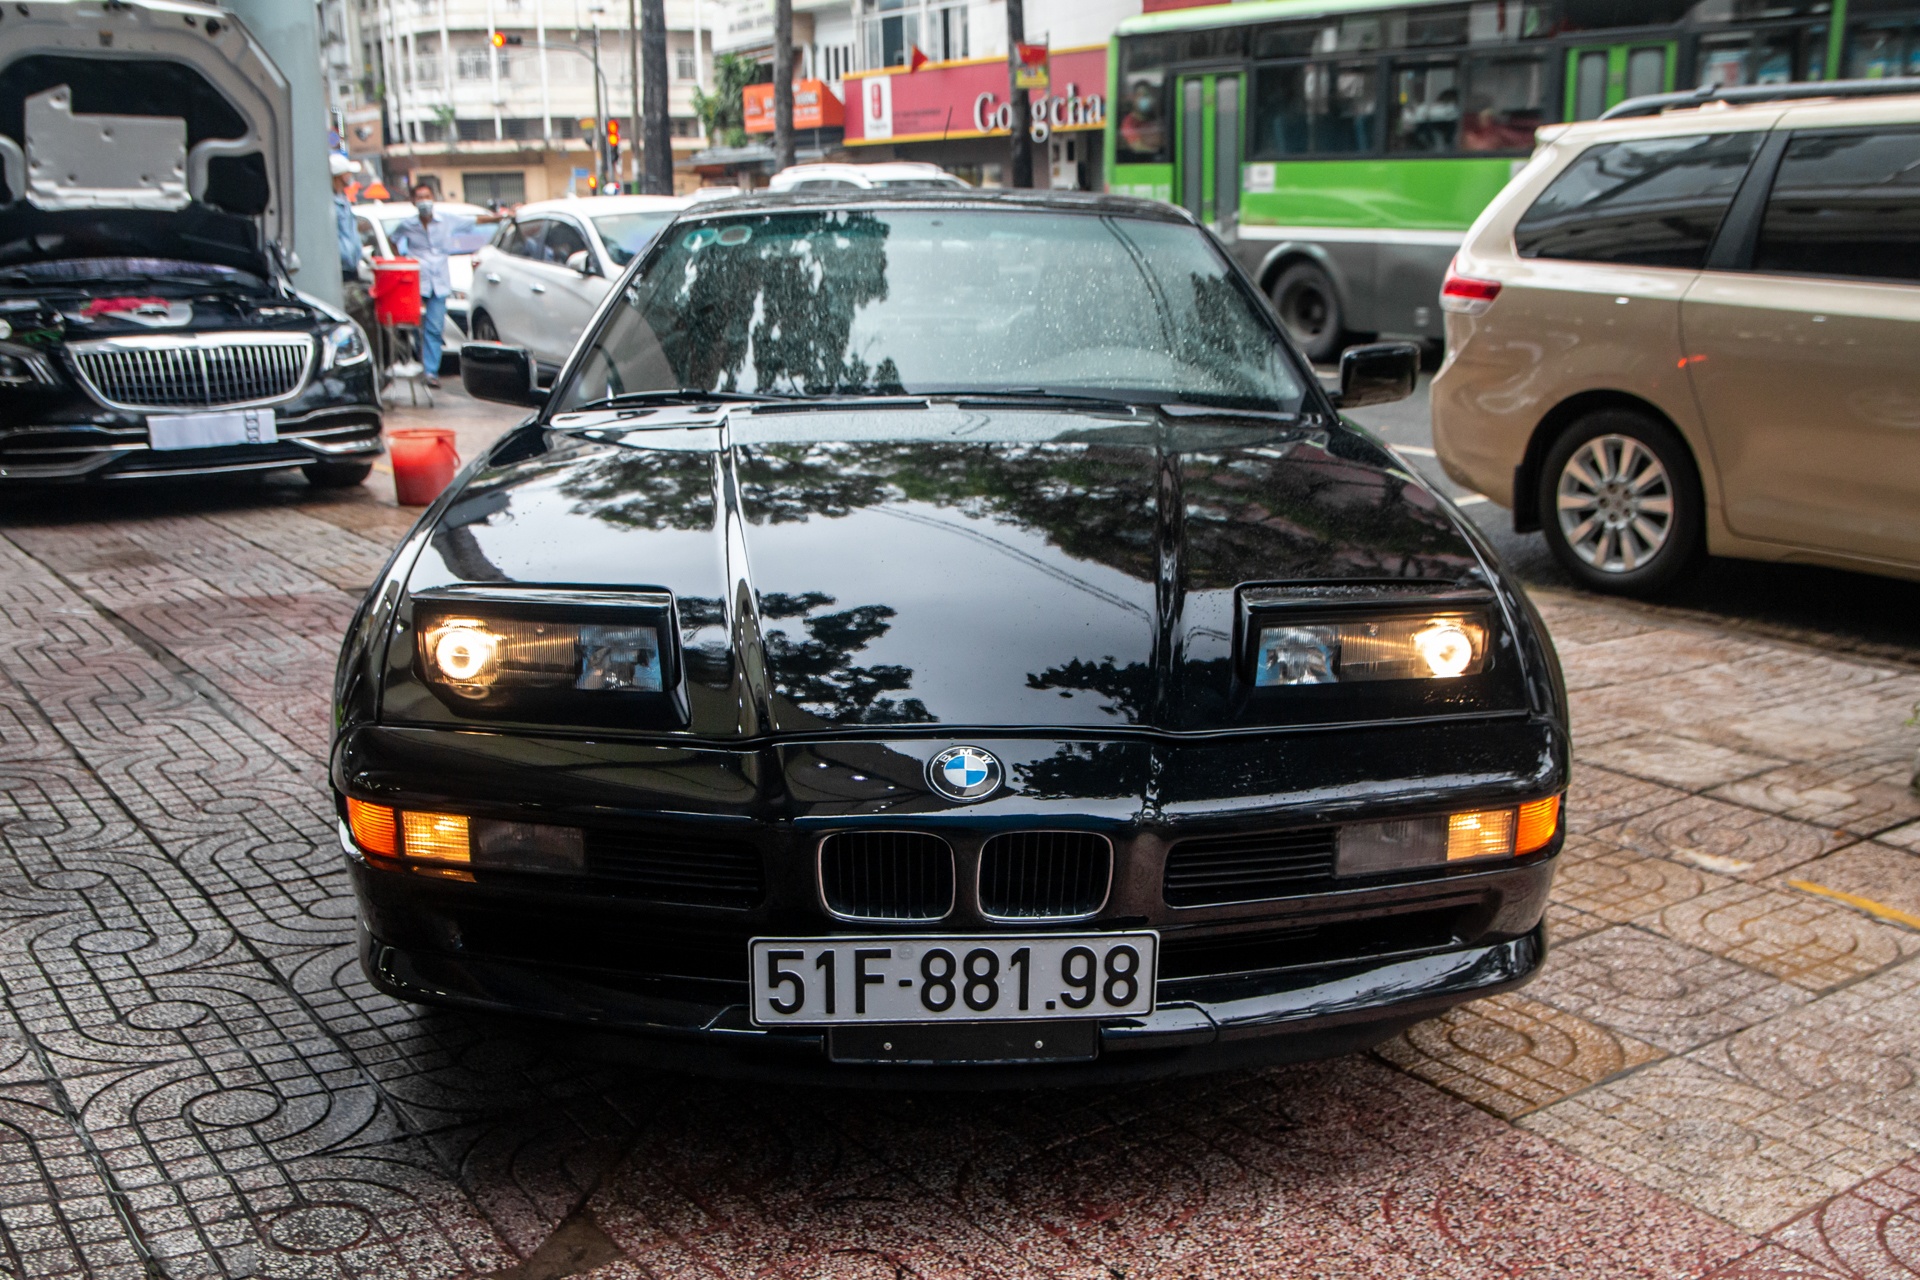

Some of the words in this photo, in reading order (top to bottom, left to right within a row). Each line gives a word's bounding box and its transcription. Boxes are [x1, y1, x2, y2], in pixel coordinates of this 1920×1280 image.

[973, 83, 1102, 143] Gogcha
[939, 749, 994, 764] BMW
[767, 944, 1140, 1015] 51F-881.98
